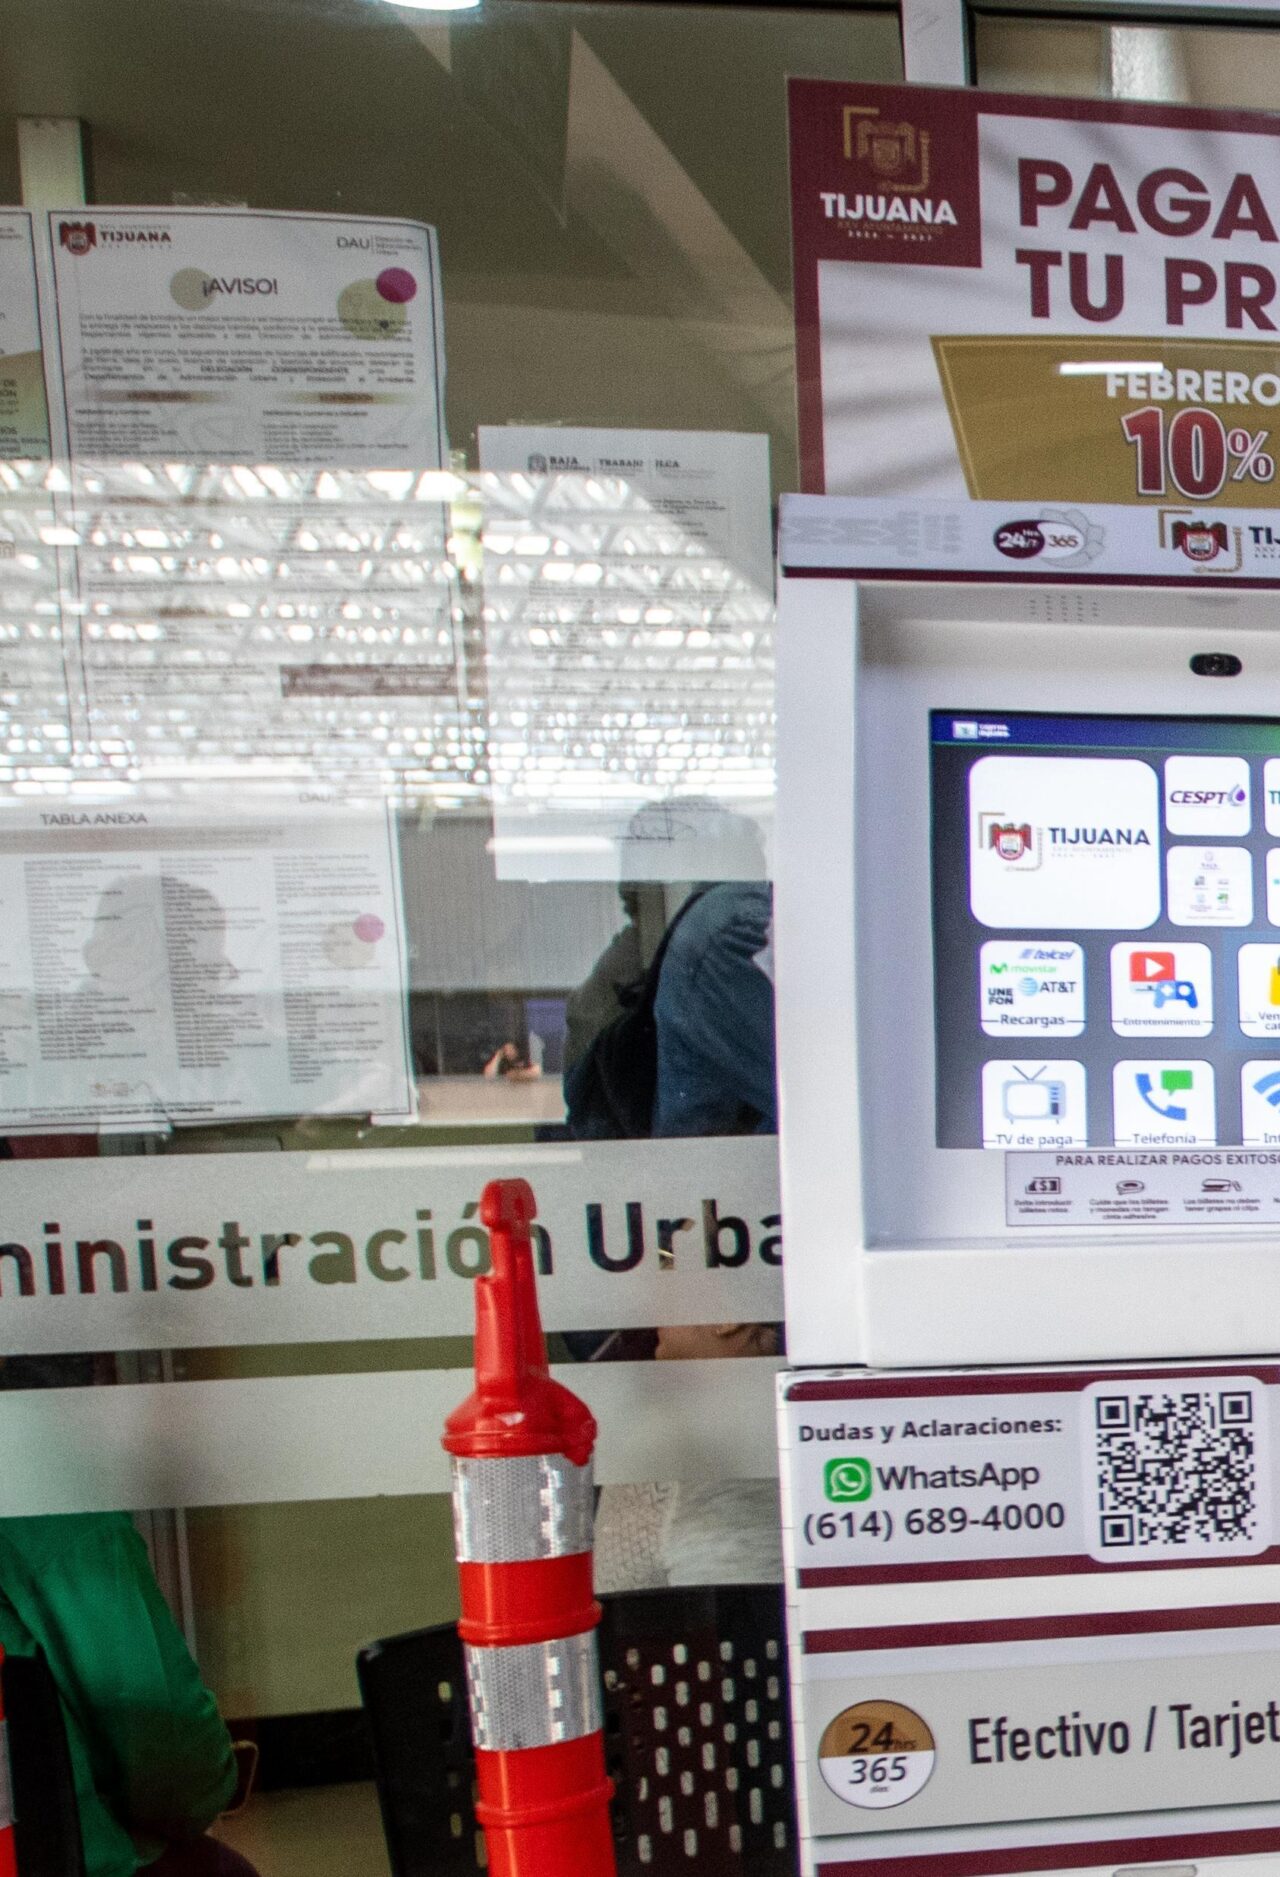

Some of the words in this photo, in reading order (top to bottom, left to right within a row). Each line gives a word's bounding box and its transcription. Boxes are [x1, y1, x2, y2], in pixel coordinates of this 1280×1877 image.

[820, 192, 958, 225] TIJUANA
[1018, 158, 1279, 243] PAGA
[101, 231, 171, 242] TIJUANA
[337, 237, 370, 249] DAU
[203, 278, 278, 297] ¡AVISO!
[1015, 249, 1125, 322] TU
[1121, 406, 1275, 500] 10%
[1049, 534, 1079, 548] 365
[1170, 790, 1227, 804] CESPT
[40, 813, 92, 826] TABLA
[95, 812, 149, 825] ANEXA
[1049, 827, 1151, 845] TIJUANA
[1040, 981, 1076, 994] AT&T
[1001, 1014, 1065, 1028] Recargas
[1123, 1017, 1201, 1027] Entretenimiento
[996, 1134, 1013, 1144] TV
[1017, 1134, 1034, 1144] de
[1038, 1136, 1073, 1148] paga
[1056, 1155, 1093, 1166] PARA
[1097, 1155, 1168, 1166] REALIZAR
[1172, 1154, 1223, 1165] PAGOS
[586, 1198, 783, 1273] Urba
[799, 1422, 874, 1442] Dudas
[880, 1426, 895, 1444] y
[902, 1416, 1062, 1439] Aclaraciones:
[877, 1463, 1040, 1493] WhatsApp
[803, 1509, 893, 1546] (614)
[905, 1501, 1065, 1536] 689-4000
[848, 1721, 894, 1754] 24
[968, 1711, 1130, 1766] Efectivo
[1144, 1706, 1158, 1754] /
[848, 1755, 907, 1784] 365
